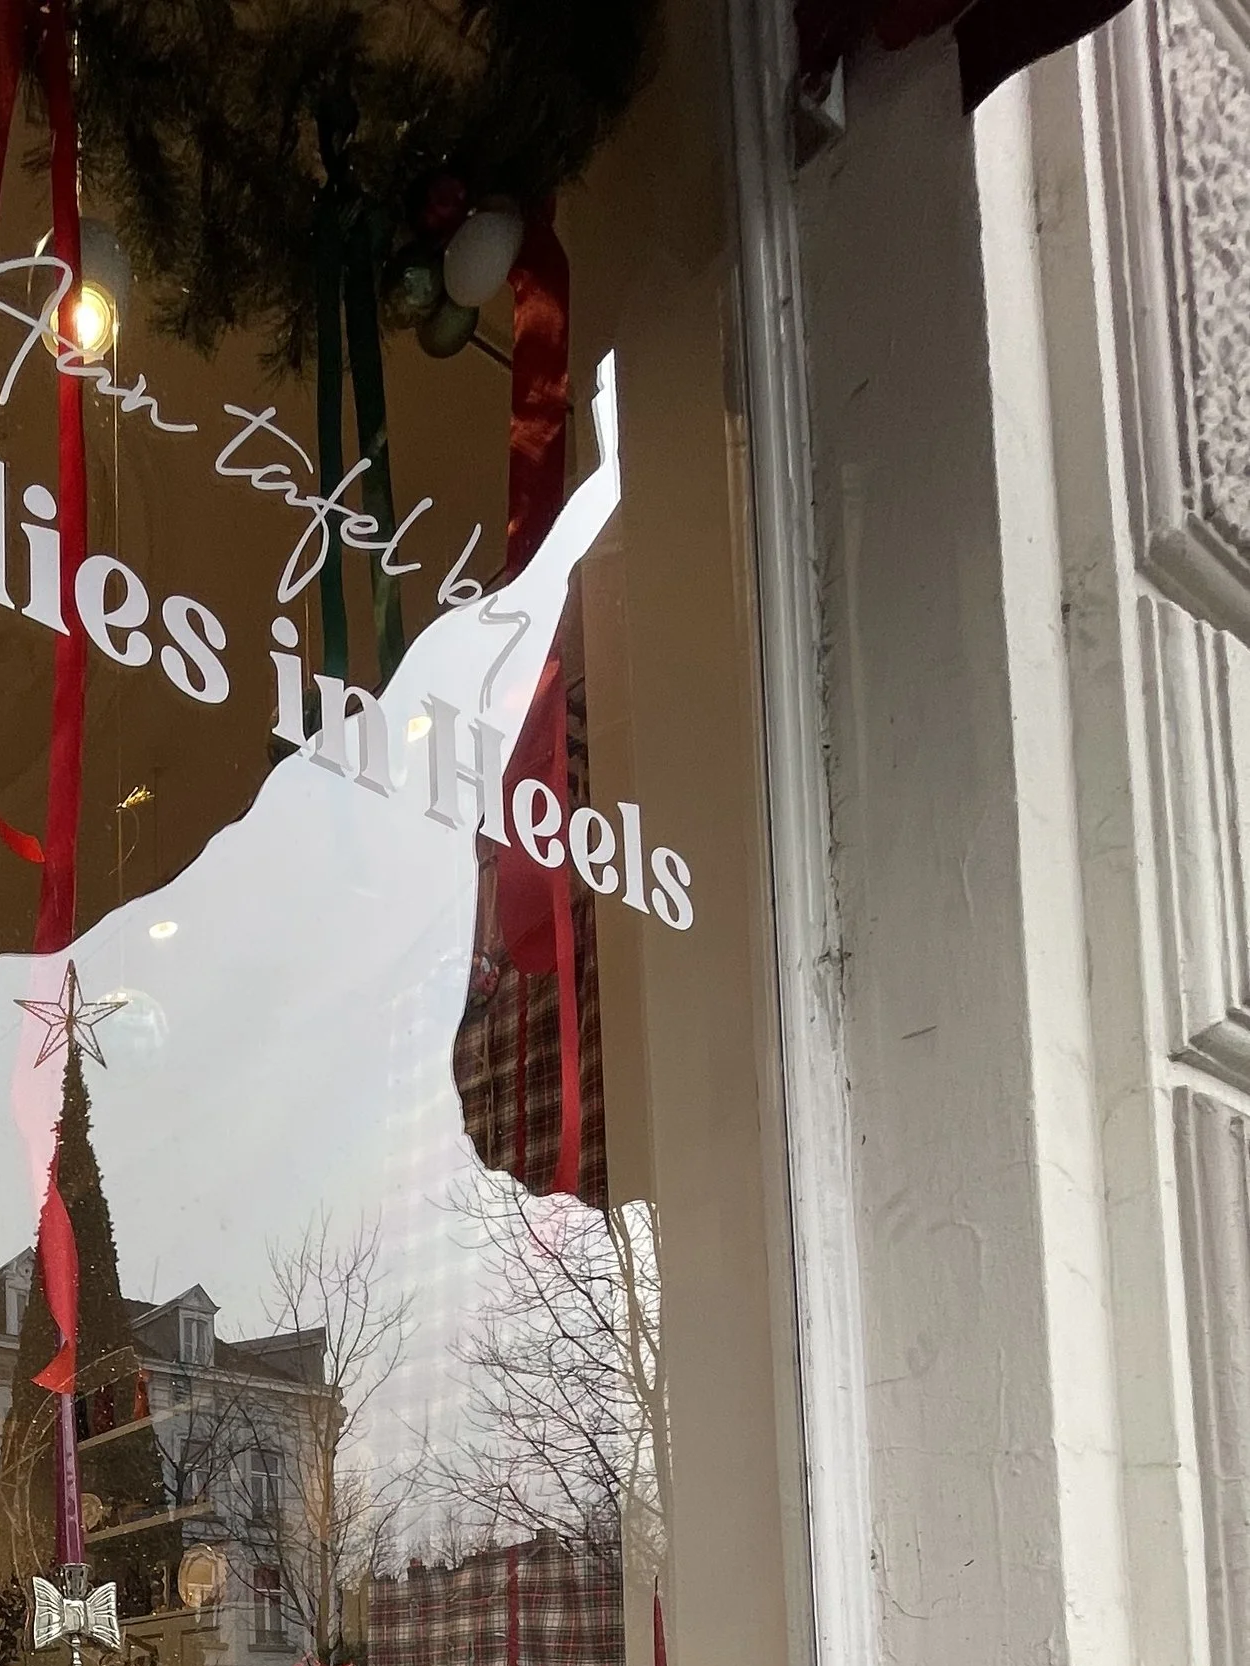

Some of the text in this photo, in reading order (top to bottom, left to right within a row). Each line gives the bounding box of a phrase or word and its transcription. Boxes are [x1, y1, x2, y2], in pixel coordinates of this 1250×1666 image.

[214, 402, 433, 604] tafel
[269, 615, 397, 798] in
[422, 691, 694, 932] Heels
